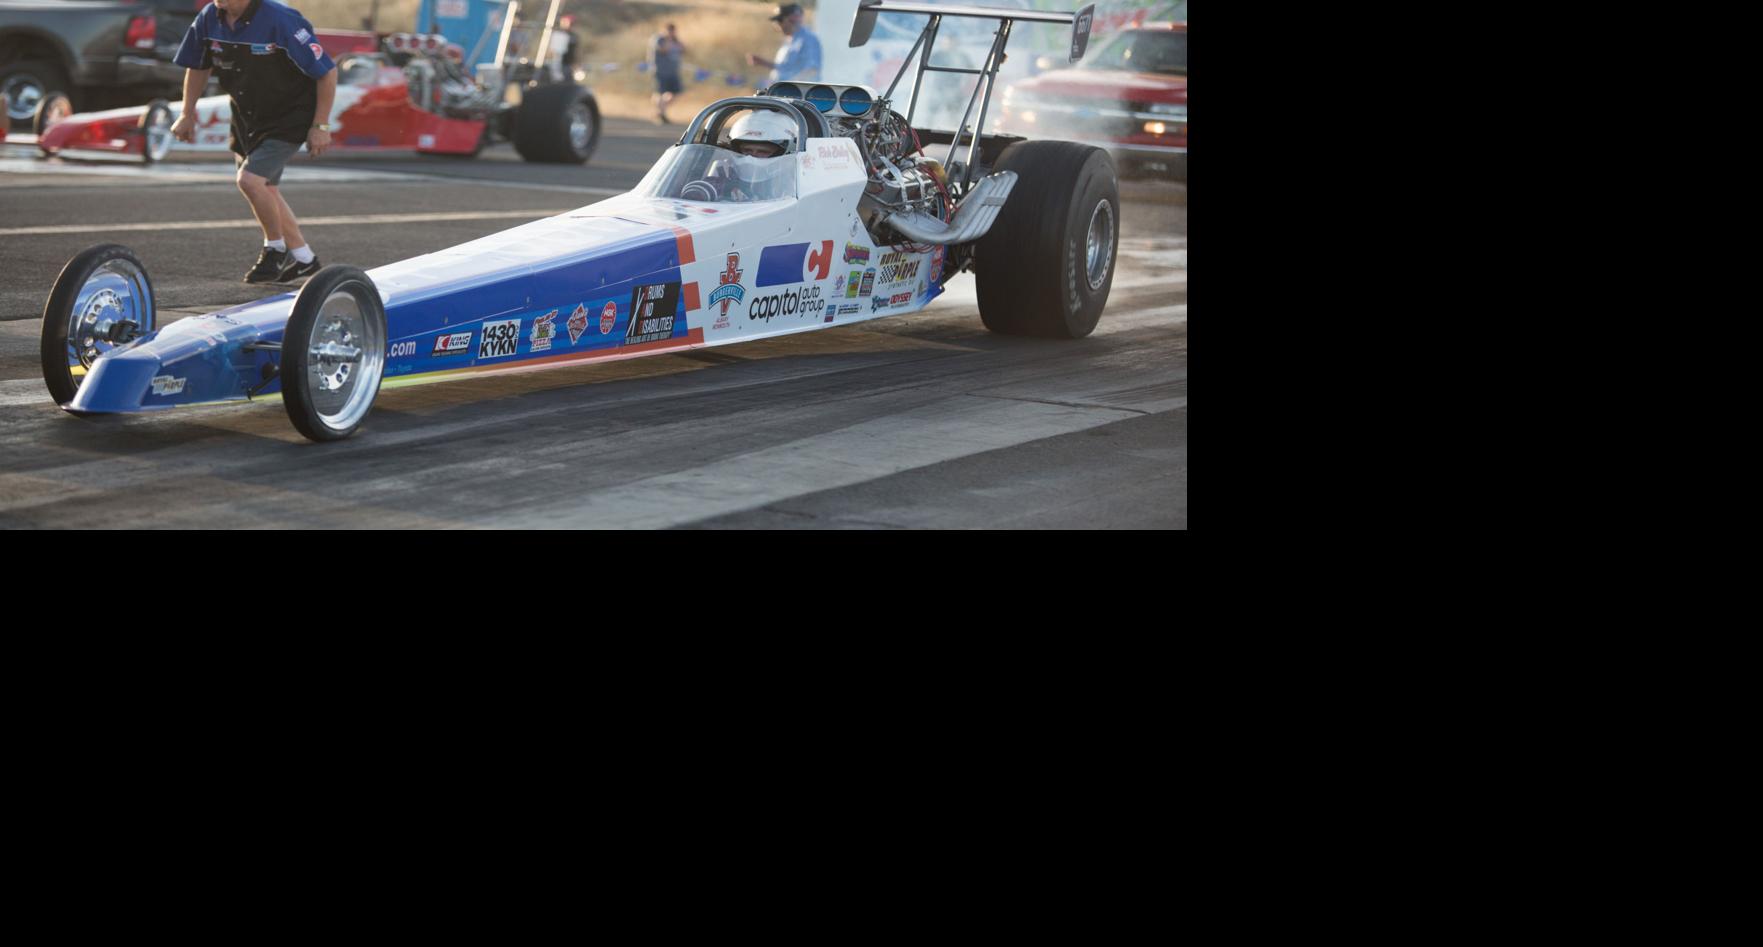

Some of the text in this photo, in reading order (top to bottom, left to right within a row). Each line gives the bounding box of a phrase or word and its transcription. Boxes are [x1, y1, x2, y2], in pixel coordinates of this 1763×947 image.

[880, 252, 902, 265] ROYAL
[749, 287, 802, 323] capitol
[802, 284, 820, 300] auto
[890, 291, 912, 304] ODYSSEY
[800, 299, 825, 318] group
[449, 335, 471, 347] KING
[482, 324, 516, 342] 1430
[480, 340, 517, 358] KYKN
